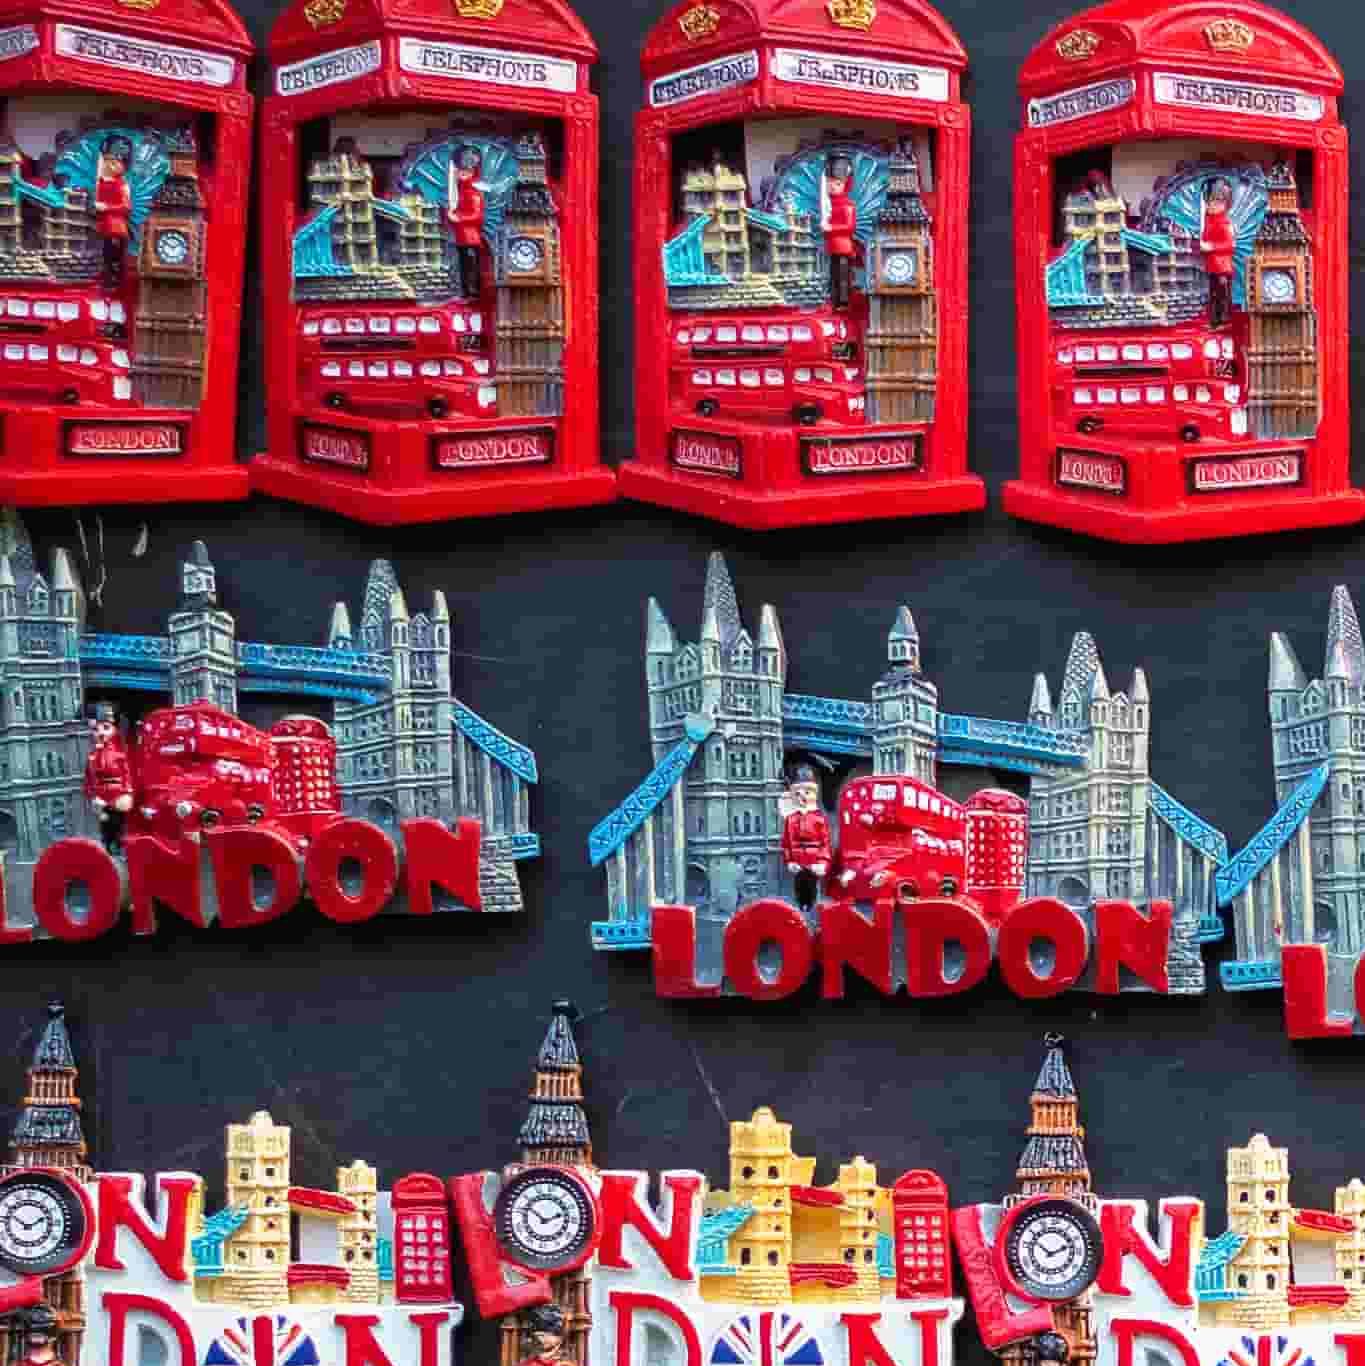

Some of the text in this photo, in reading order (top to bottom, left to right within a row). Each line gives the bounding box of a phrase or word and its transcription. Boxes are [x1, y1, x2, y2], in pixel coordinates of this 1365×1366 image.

[416, 47, 547, 83] TELEPHONE
[794, 61, 919, 93] TELEPHONE
[1172, 80, 1298, 114] TELEPHONE
[812, 440, 909, 468] LONDON
[1197, 456, 1292, 485] LONDON
[650, 896, 1174, 1002] LONDON
